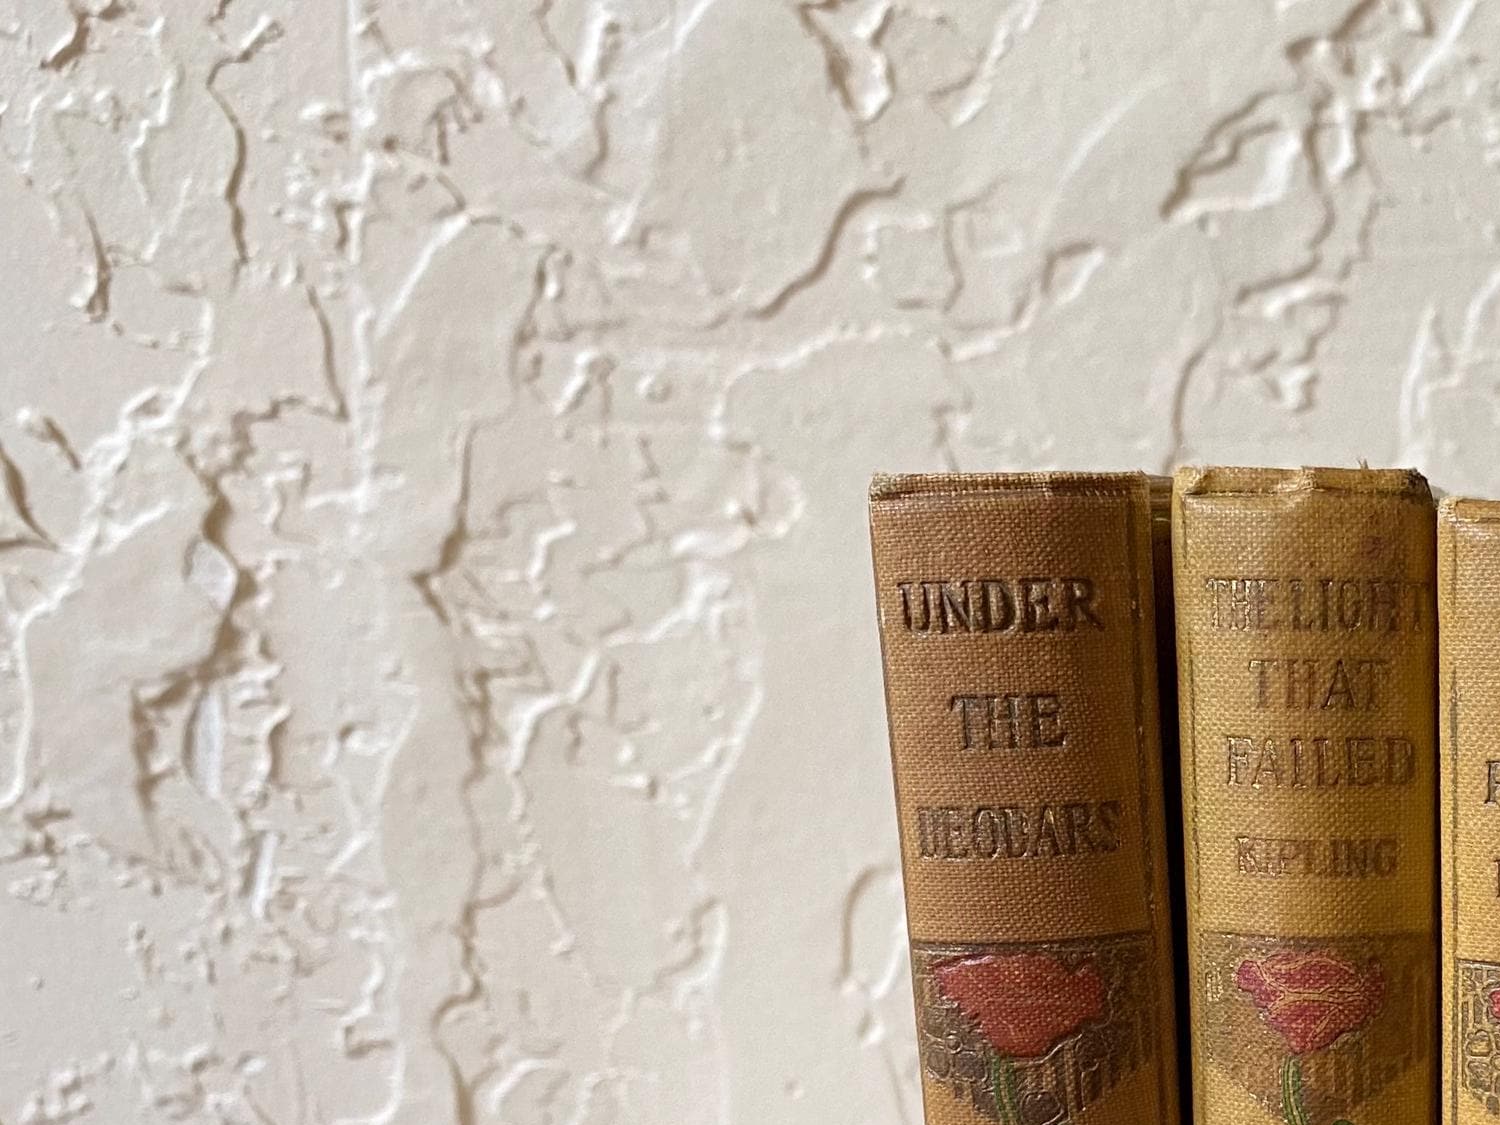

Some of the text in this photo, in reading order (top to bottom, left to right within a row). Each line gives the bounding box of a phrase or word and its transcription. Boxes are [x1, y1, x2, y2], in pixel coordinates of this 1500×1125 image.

[897, 577, 1104, 634] UNDER
[1249, 658, 1390, 711] THAT
[951, 694, 1068, 750] THE
[1226, 736, 1416, 789] FAILED
